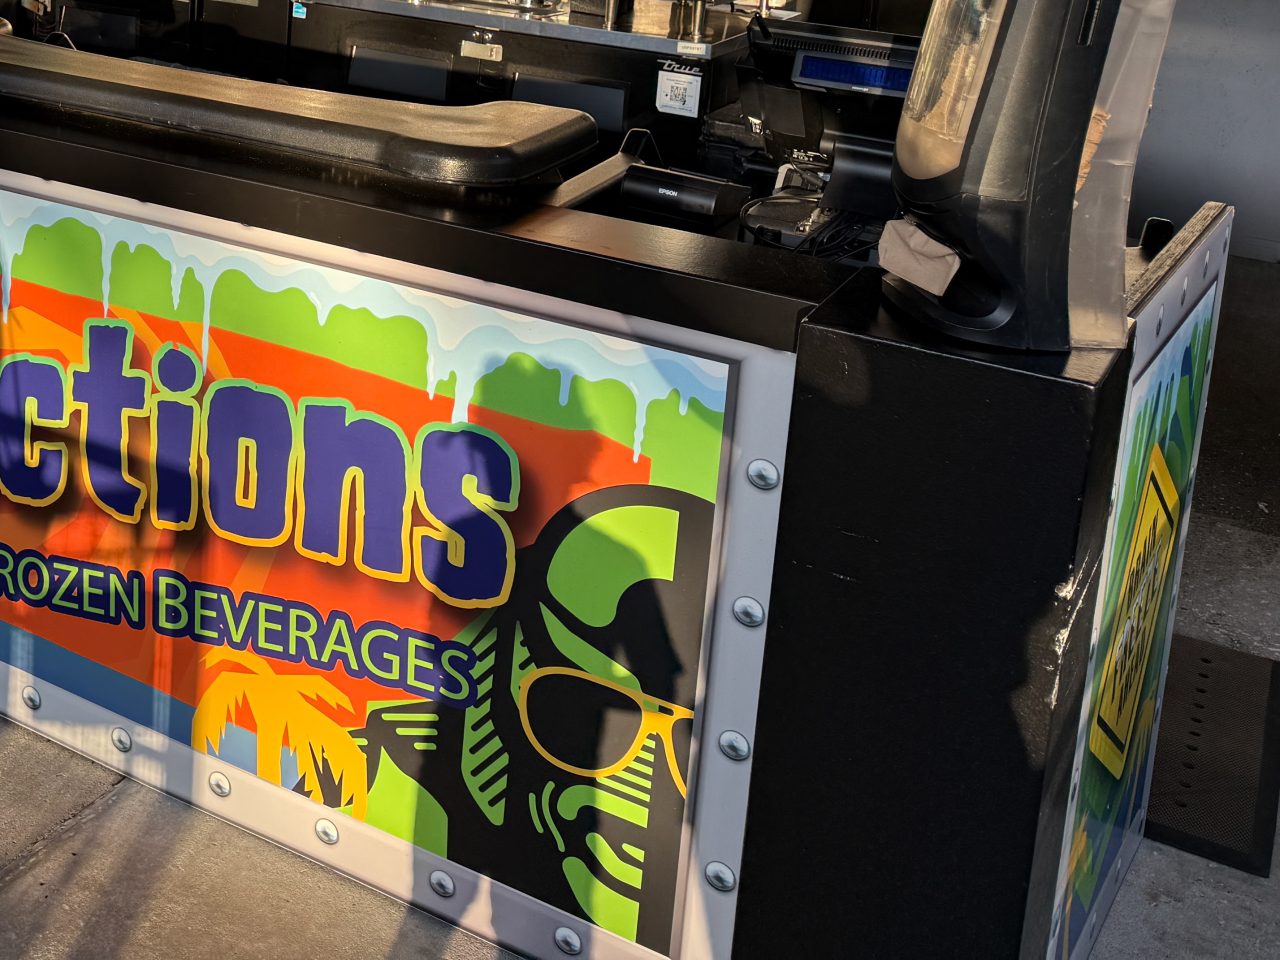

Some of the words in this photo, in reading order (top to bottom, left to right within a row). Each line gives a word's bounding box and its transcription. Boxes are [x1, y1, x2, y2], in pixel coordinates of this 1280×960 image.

[658, 187, 678, 197] EPSON
[1126, 507, 1160, 608] BRAIN
[157, 574, 477, 704] BEVERAGES
[1111, 534, 1162, 705] FREEZE
[1116, 628, 1147, 725] AHEAD
